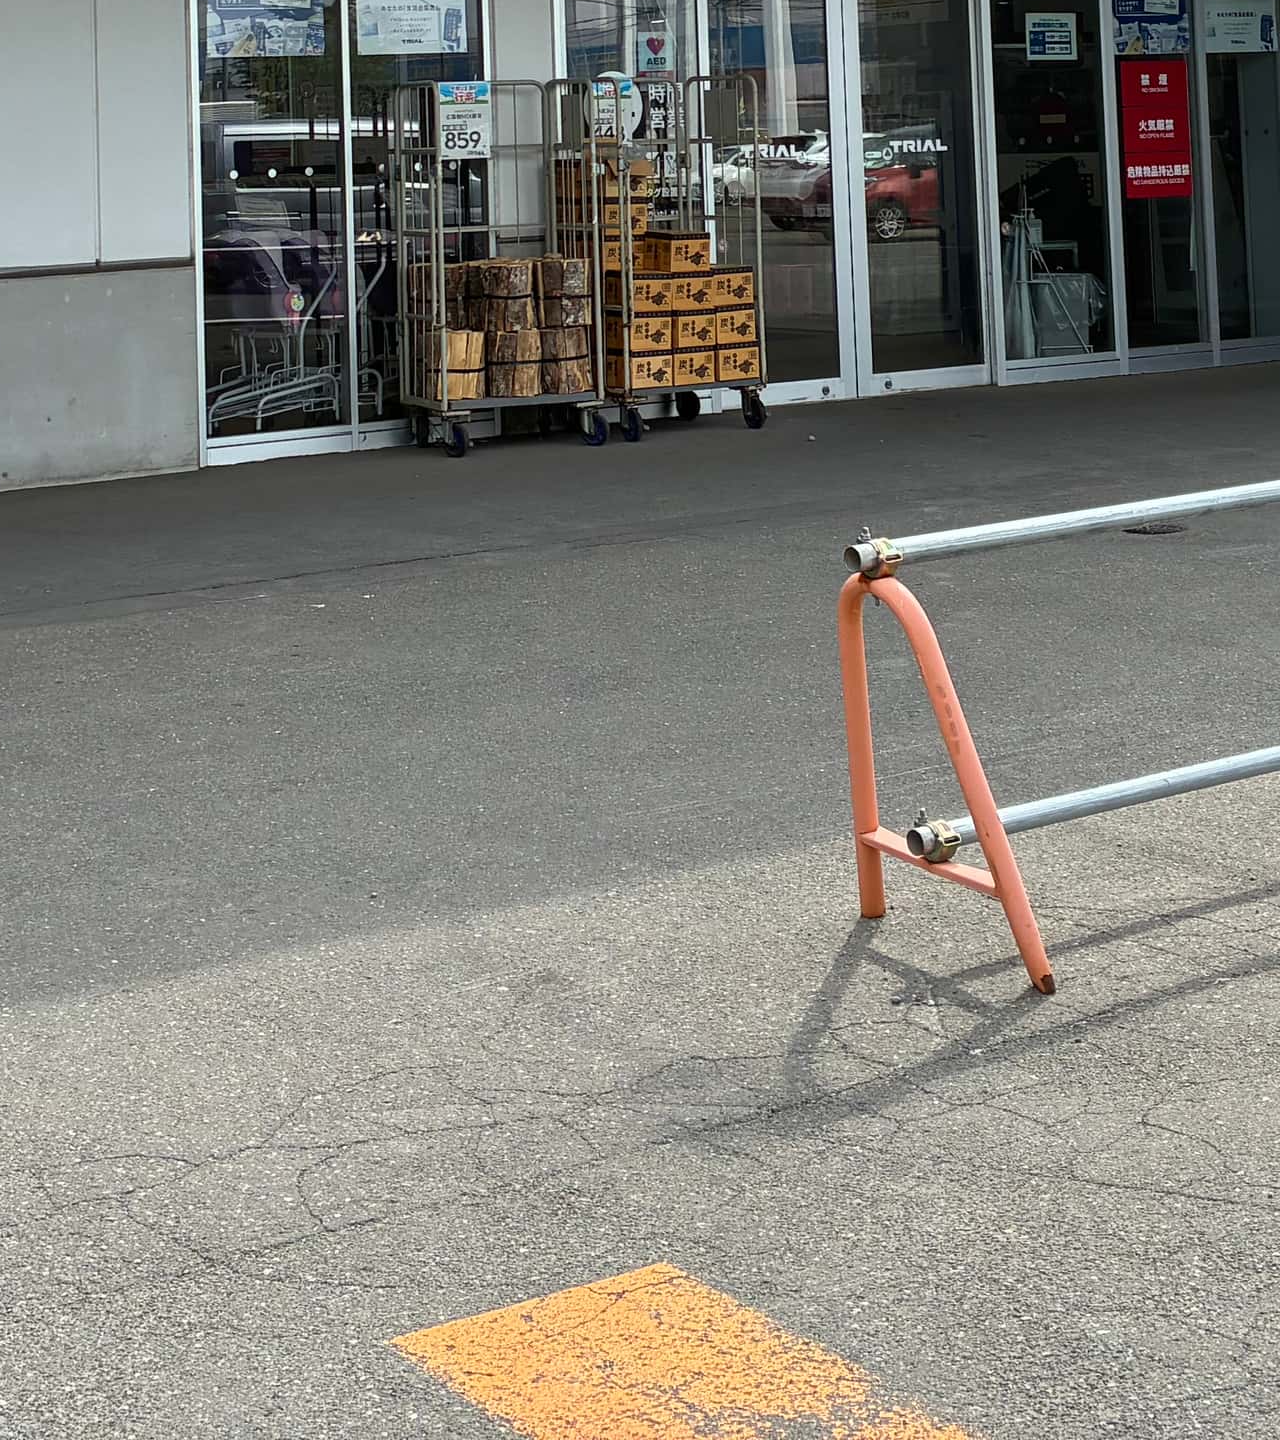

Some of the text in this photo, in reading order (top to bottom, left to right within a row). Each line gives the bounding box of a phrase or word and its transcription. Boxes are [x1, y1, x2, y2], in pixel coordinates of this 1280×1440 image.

[646, 56, 667, 66] AED
[444, 131, 481, 150] 859
[889, 138, 949, 153] TRIAL
[741, 143, 802, 159] TRIAL
